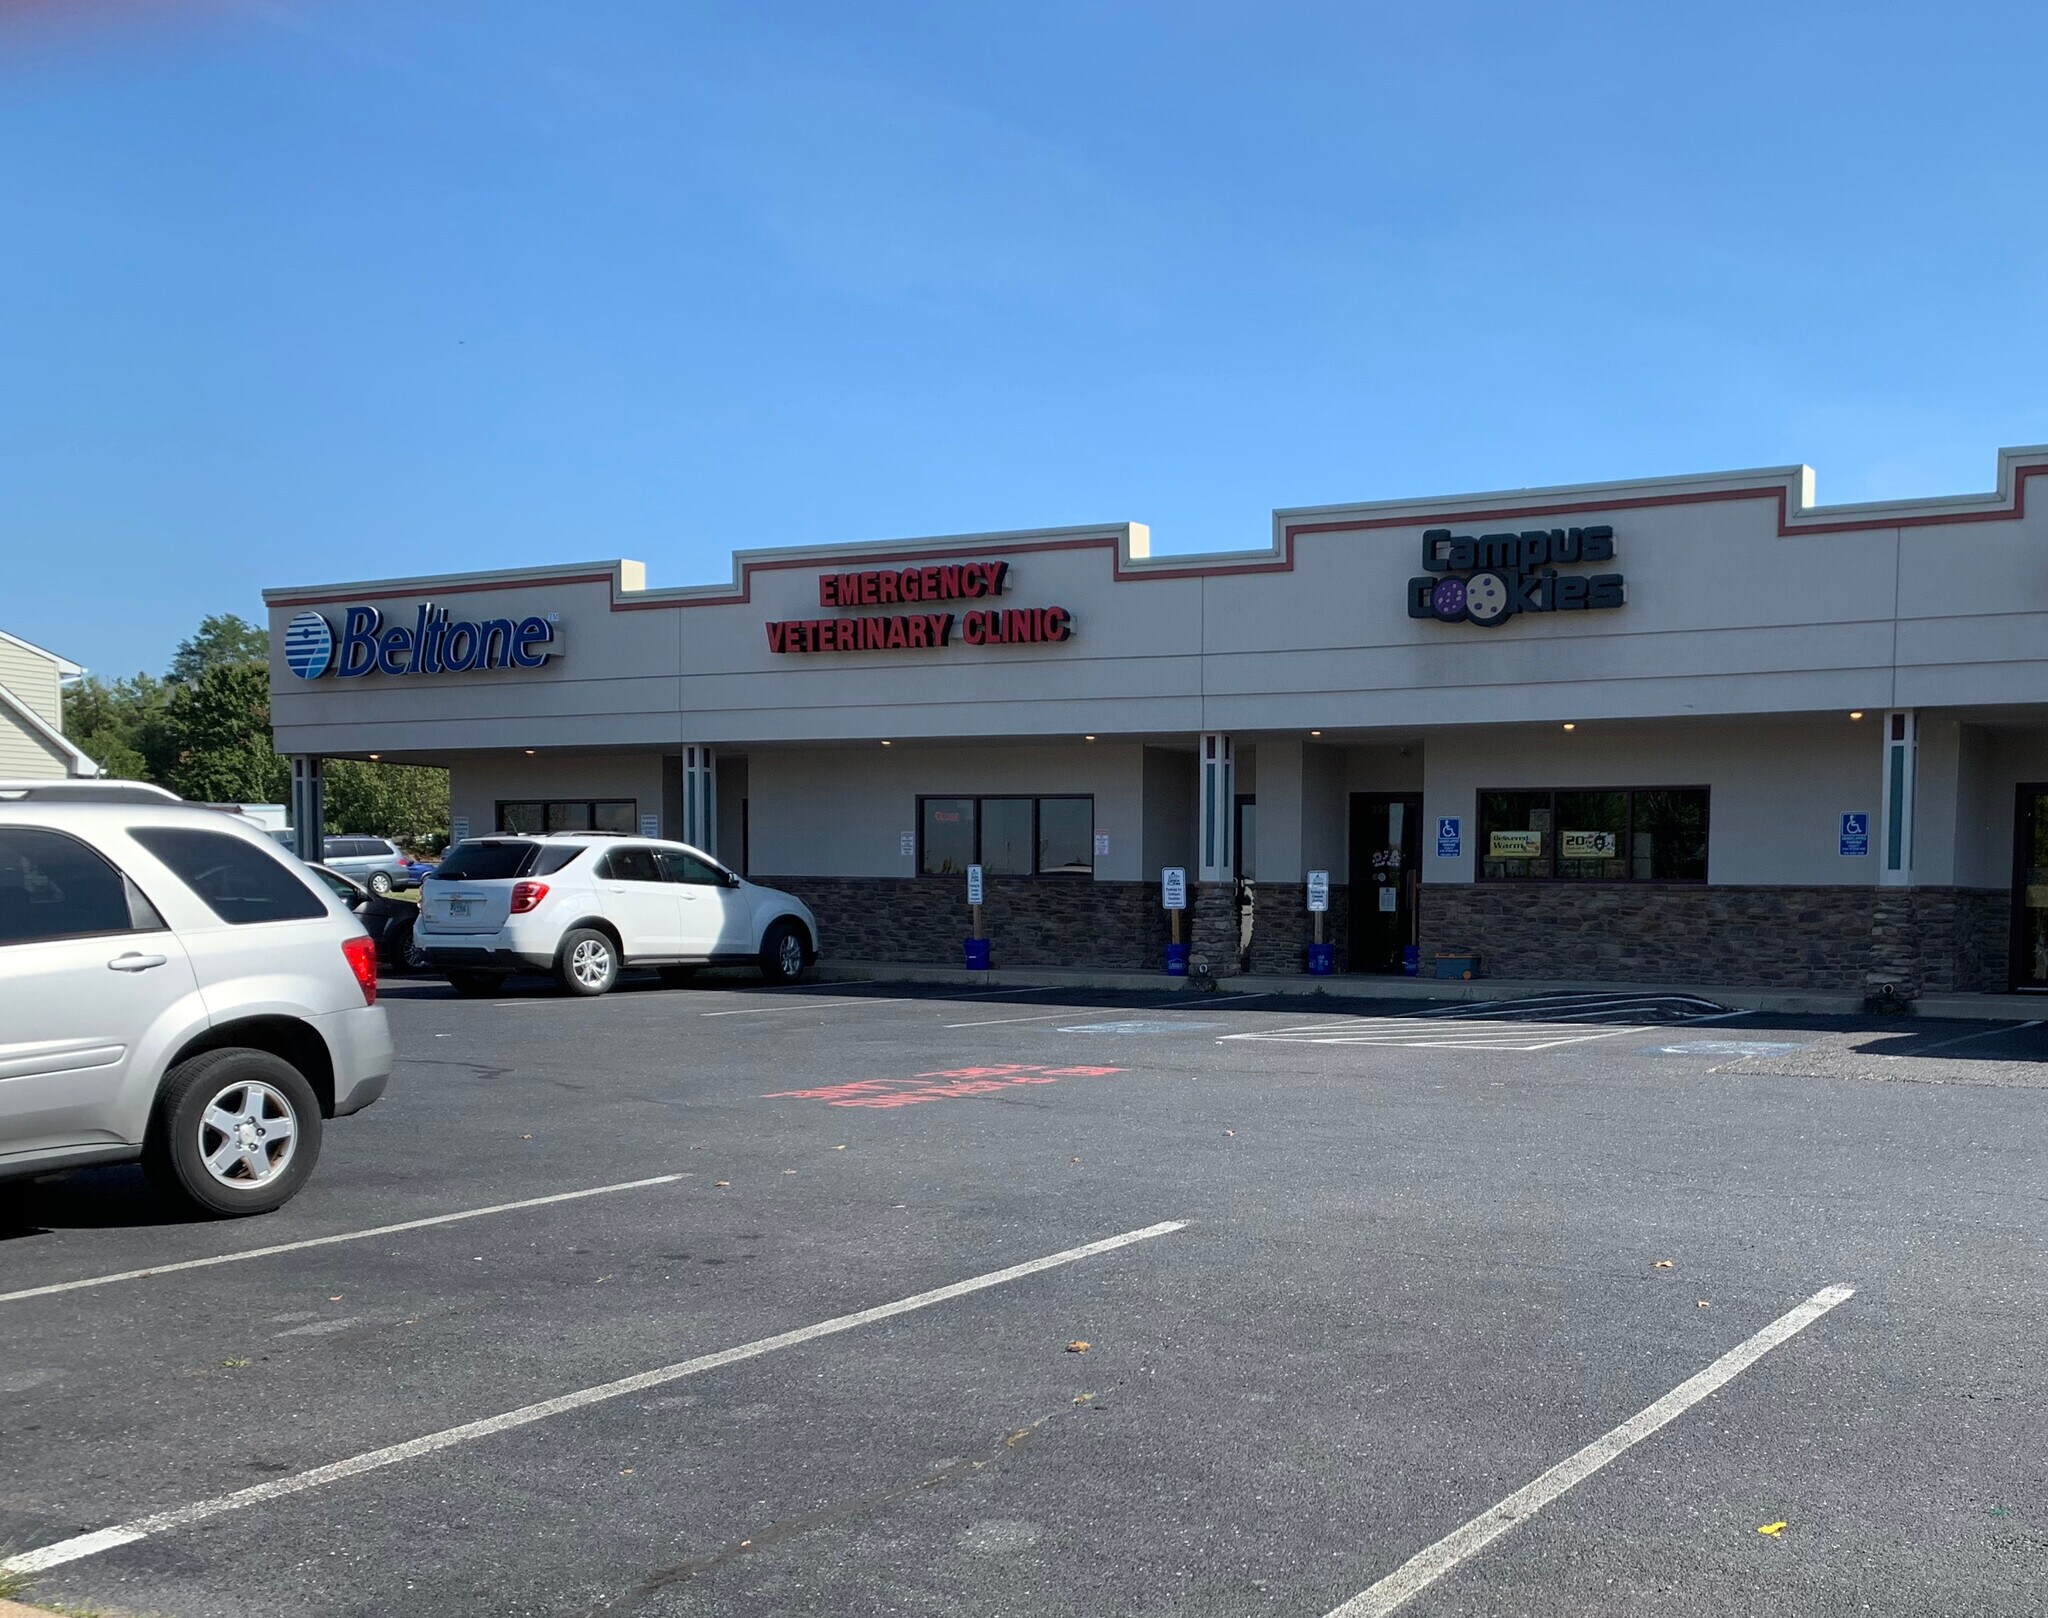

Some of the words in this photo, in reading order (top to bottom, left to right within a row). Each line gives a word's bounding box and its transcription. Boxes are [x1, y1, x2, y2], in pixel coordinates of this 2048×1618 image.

[1422, 525, 1613, 575] Campus
[819, 561, 1008, 607] EMERGENCY
[1408, 567, 1624, 627] Cookies
[335, 602, 555, 679] Beltone
[765, 613, 954, 653] VETERINARY
[963, 606, 1070, 645] CLINIC
[1566, 836, 1585, 846] 20
